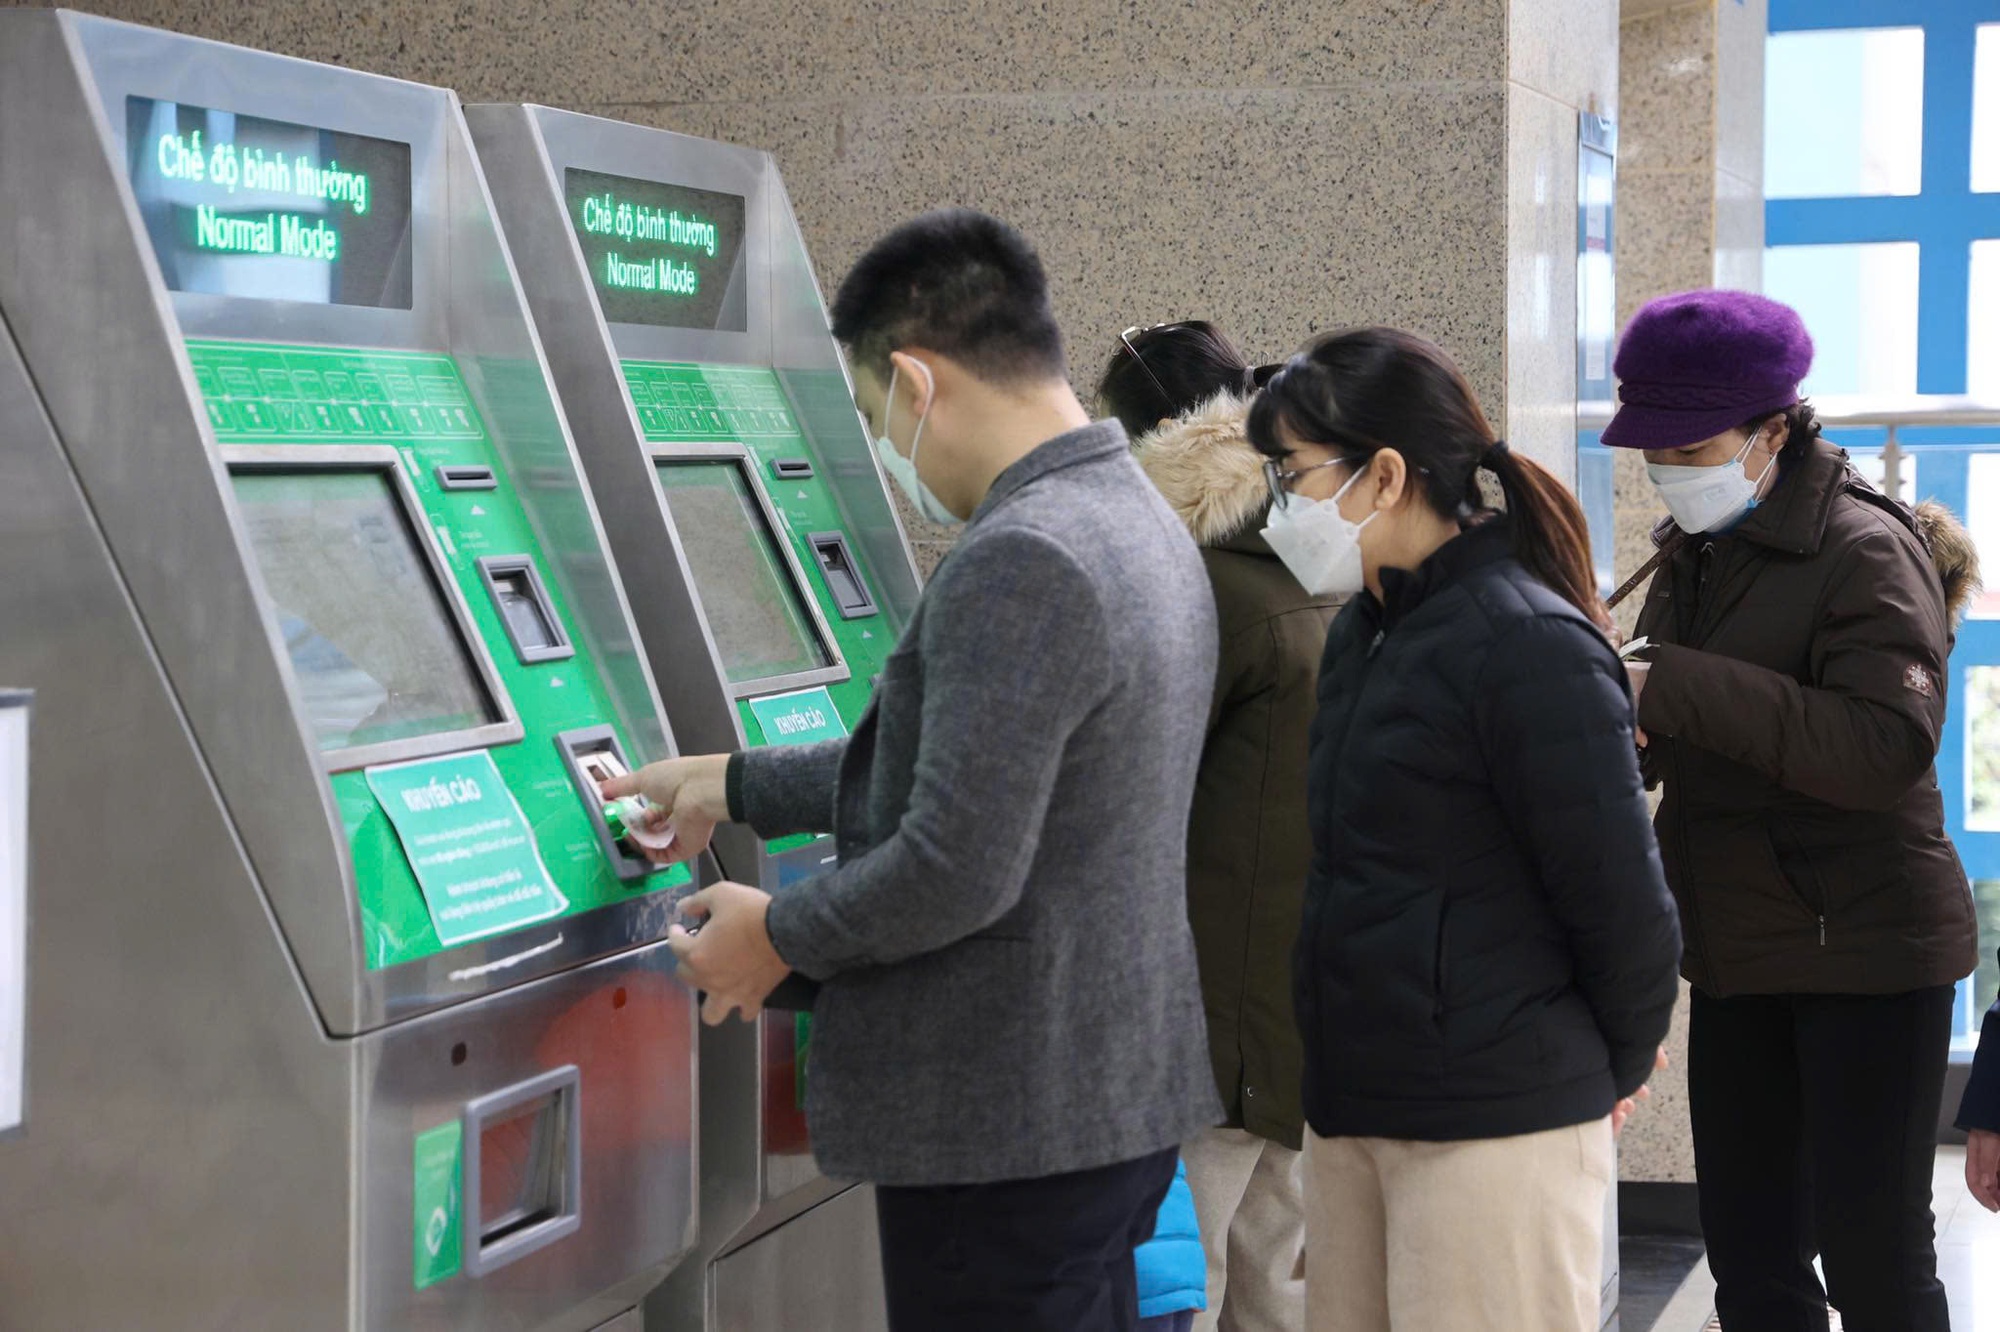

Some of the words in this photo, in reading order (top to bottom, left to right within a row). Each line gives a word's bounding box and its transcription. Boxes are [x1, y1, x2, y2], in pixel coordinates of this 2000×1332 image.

[158, 130, 205, 181] Chế
[210, 143, 239, 193] độ
[243, 148, 291, 192] bình
[294, 156, 367, 214] thường
[197, 203, 274, 253] Normal
[280, 214, 337, 260] Mode
[584, 194, 612, 234] Chế
[616, 203, 633, 242] độ
[637, 206, 666, 240] bình
[669, 210, 715, 257] thường
[607, 252, 655, 290] Normal
[659, 258, 695, 294] Mode
[806, 706, 826, 728] CÁO
